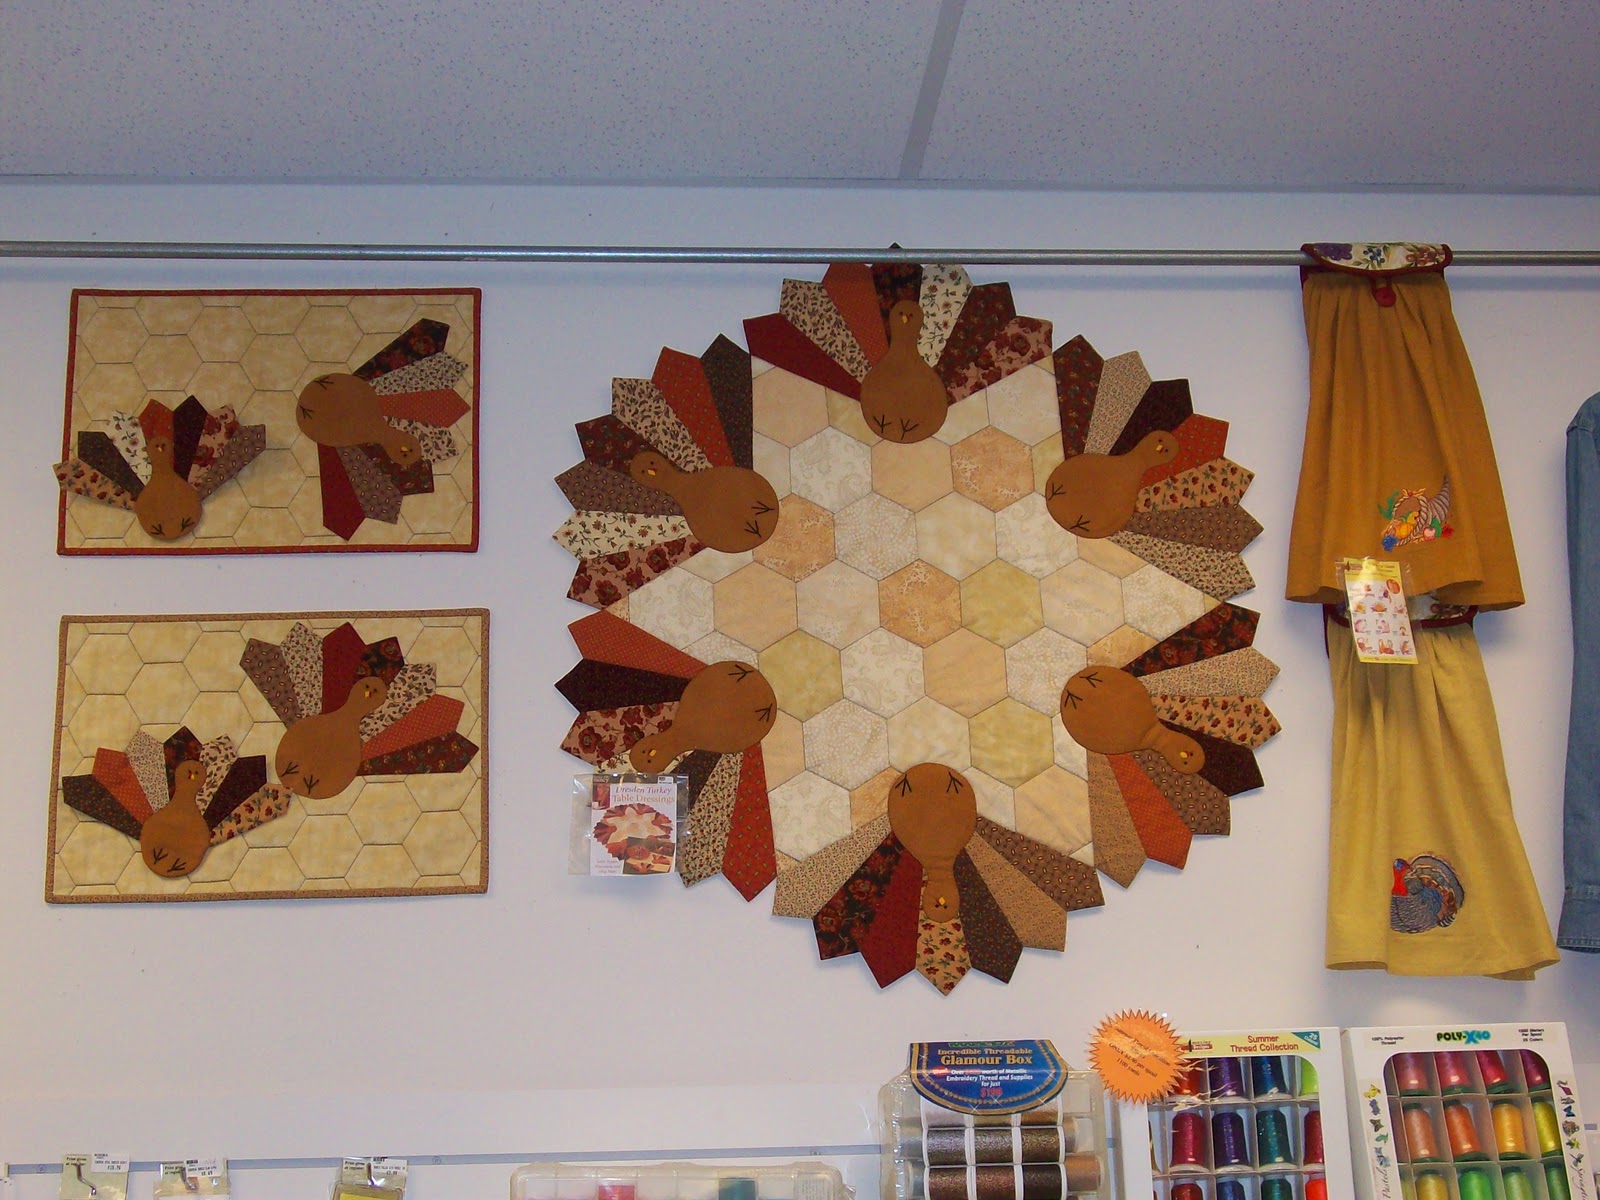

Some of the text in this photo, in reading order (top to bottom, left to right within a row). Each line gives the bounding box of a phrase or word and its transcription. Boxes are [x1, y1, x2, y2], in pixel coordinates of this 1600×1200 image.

[616, 786, 672, 795] Dresden Turkey
[613, 794, 633, 803] Table
[1247, 1035, 1279, 1043] Summer
[1230, 1042, 1299, 1052] Thread Collection
[940, 1055, 1033, 1065] Glamour Box
